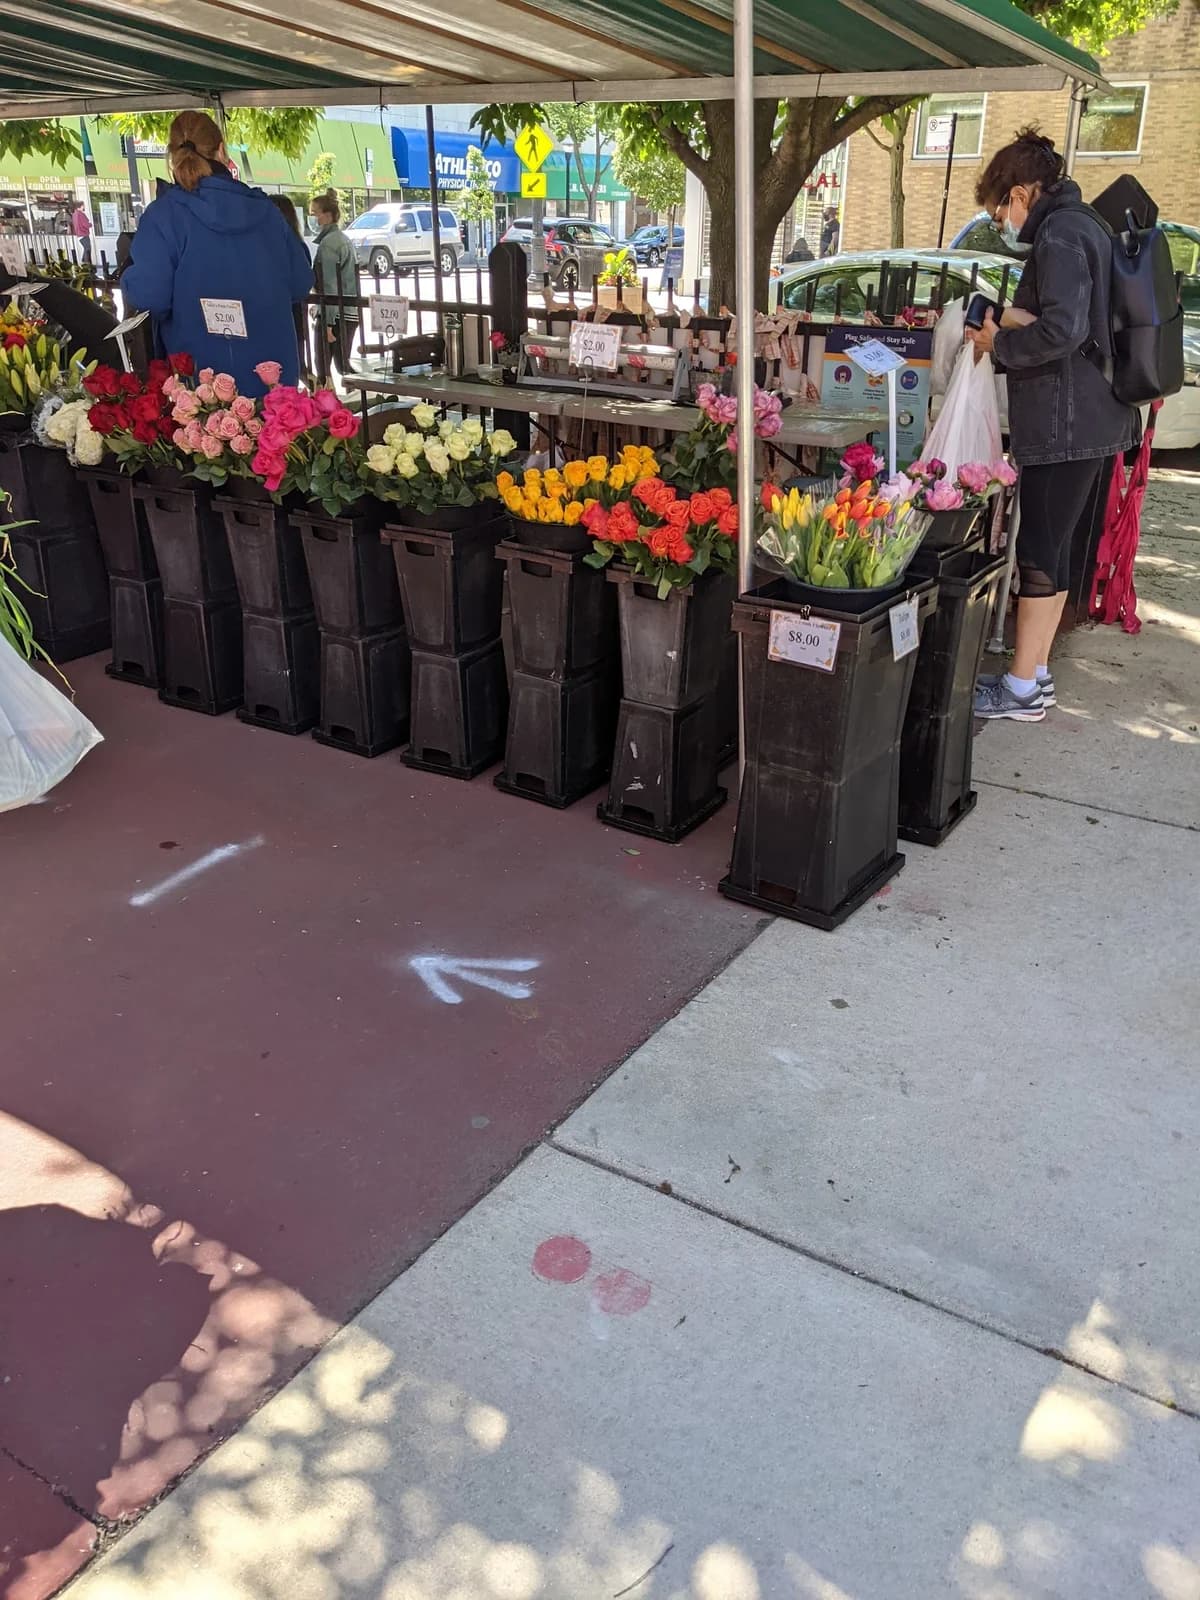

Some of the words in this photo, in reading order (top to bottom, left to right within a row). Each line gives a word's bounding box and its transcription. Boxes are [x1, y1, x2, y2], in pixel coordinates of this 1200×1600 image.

[435, 153, 502, 178] ATHLECO
[46, 183, 73, 191] DINNER
[215, 312, 235, 323] $2.00
[380, 308, 399, 320] $2.00
[845, 333, 858, 341] Play
[886, 336, 900, 345] Stay
[901, 336, 916, 345] Safe
[583, 339, 605, 352] $2.00
[788, 630, 820, 648] $8.00
